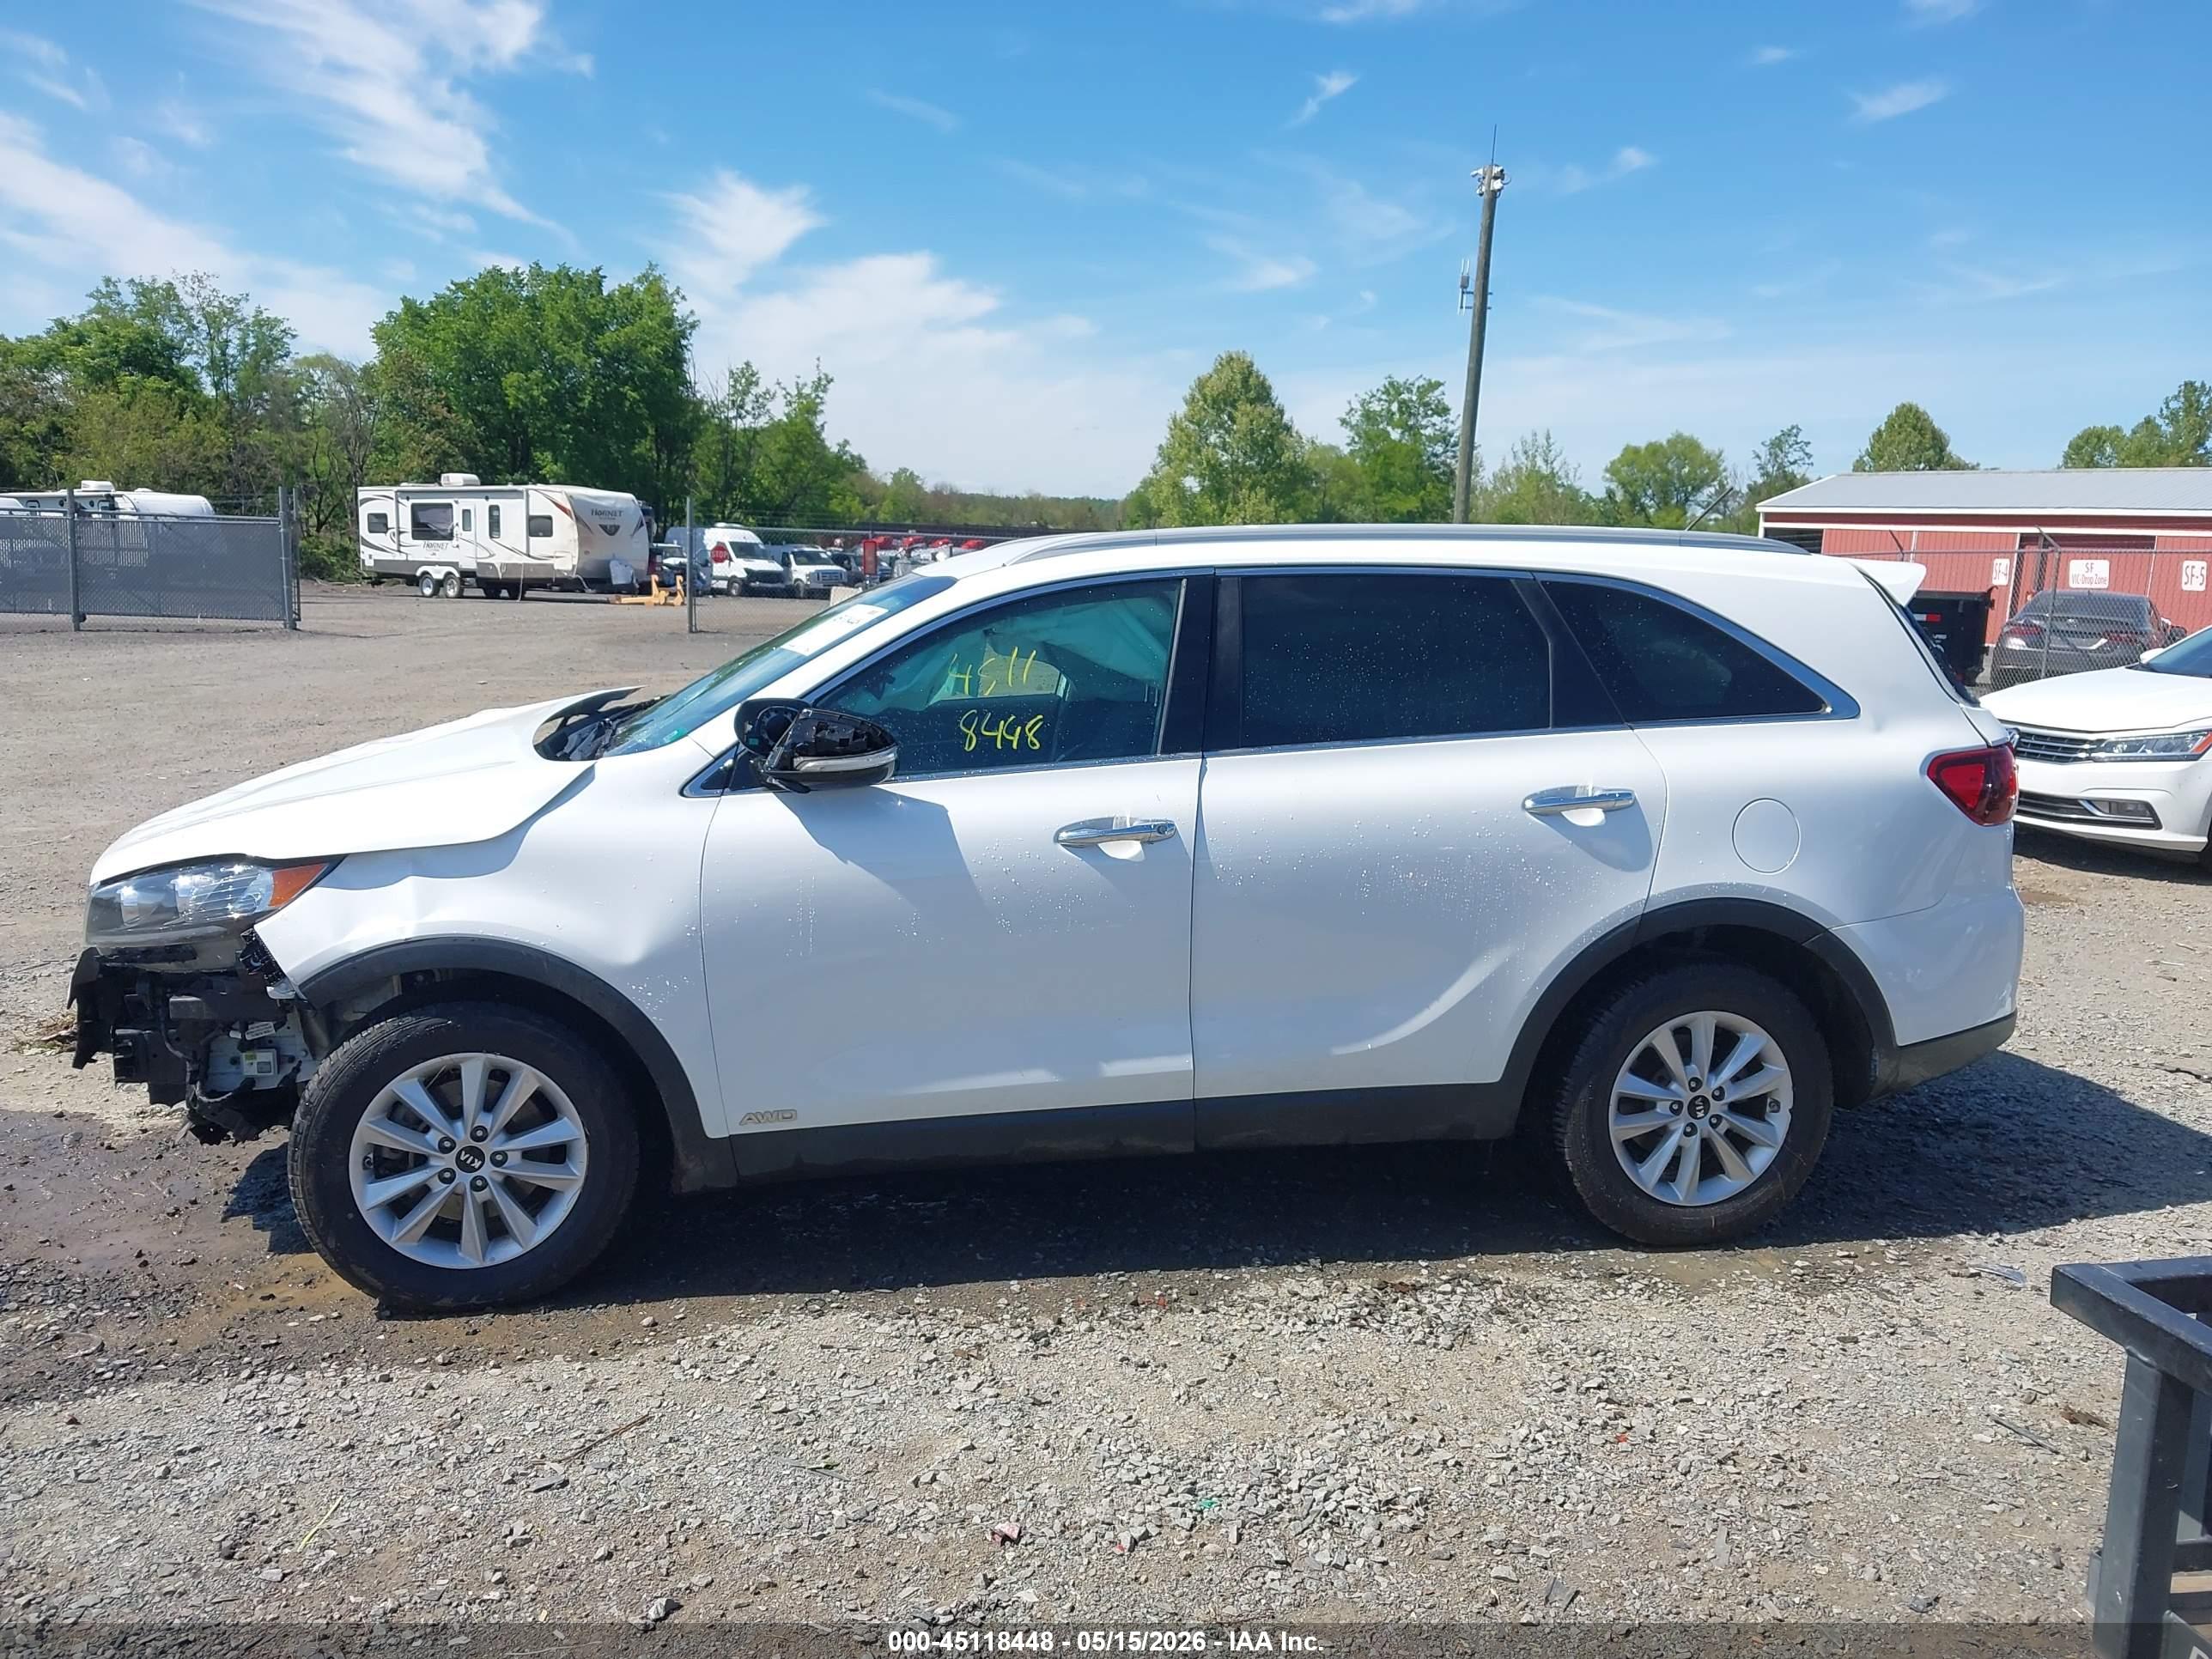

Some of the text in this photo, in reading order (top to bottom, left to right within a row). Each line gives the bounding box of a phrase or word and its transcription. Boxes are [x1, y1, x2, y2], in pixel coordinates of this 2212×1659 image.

[711, 550, 728, 559] STOP
[1993, 562, 2008, 581] SF-4
[2085, 562, 2095, 574] SF
[2184, 564, 2206, 586] SF-5
[2094, 574, 2108, 586] Zone
[959, 709, 1044, 752] 8448
[738, 1109, 798, 1127] AWD
[459, 1151, 483, 1170] KIA
